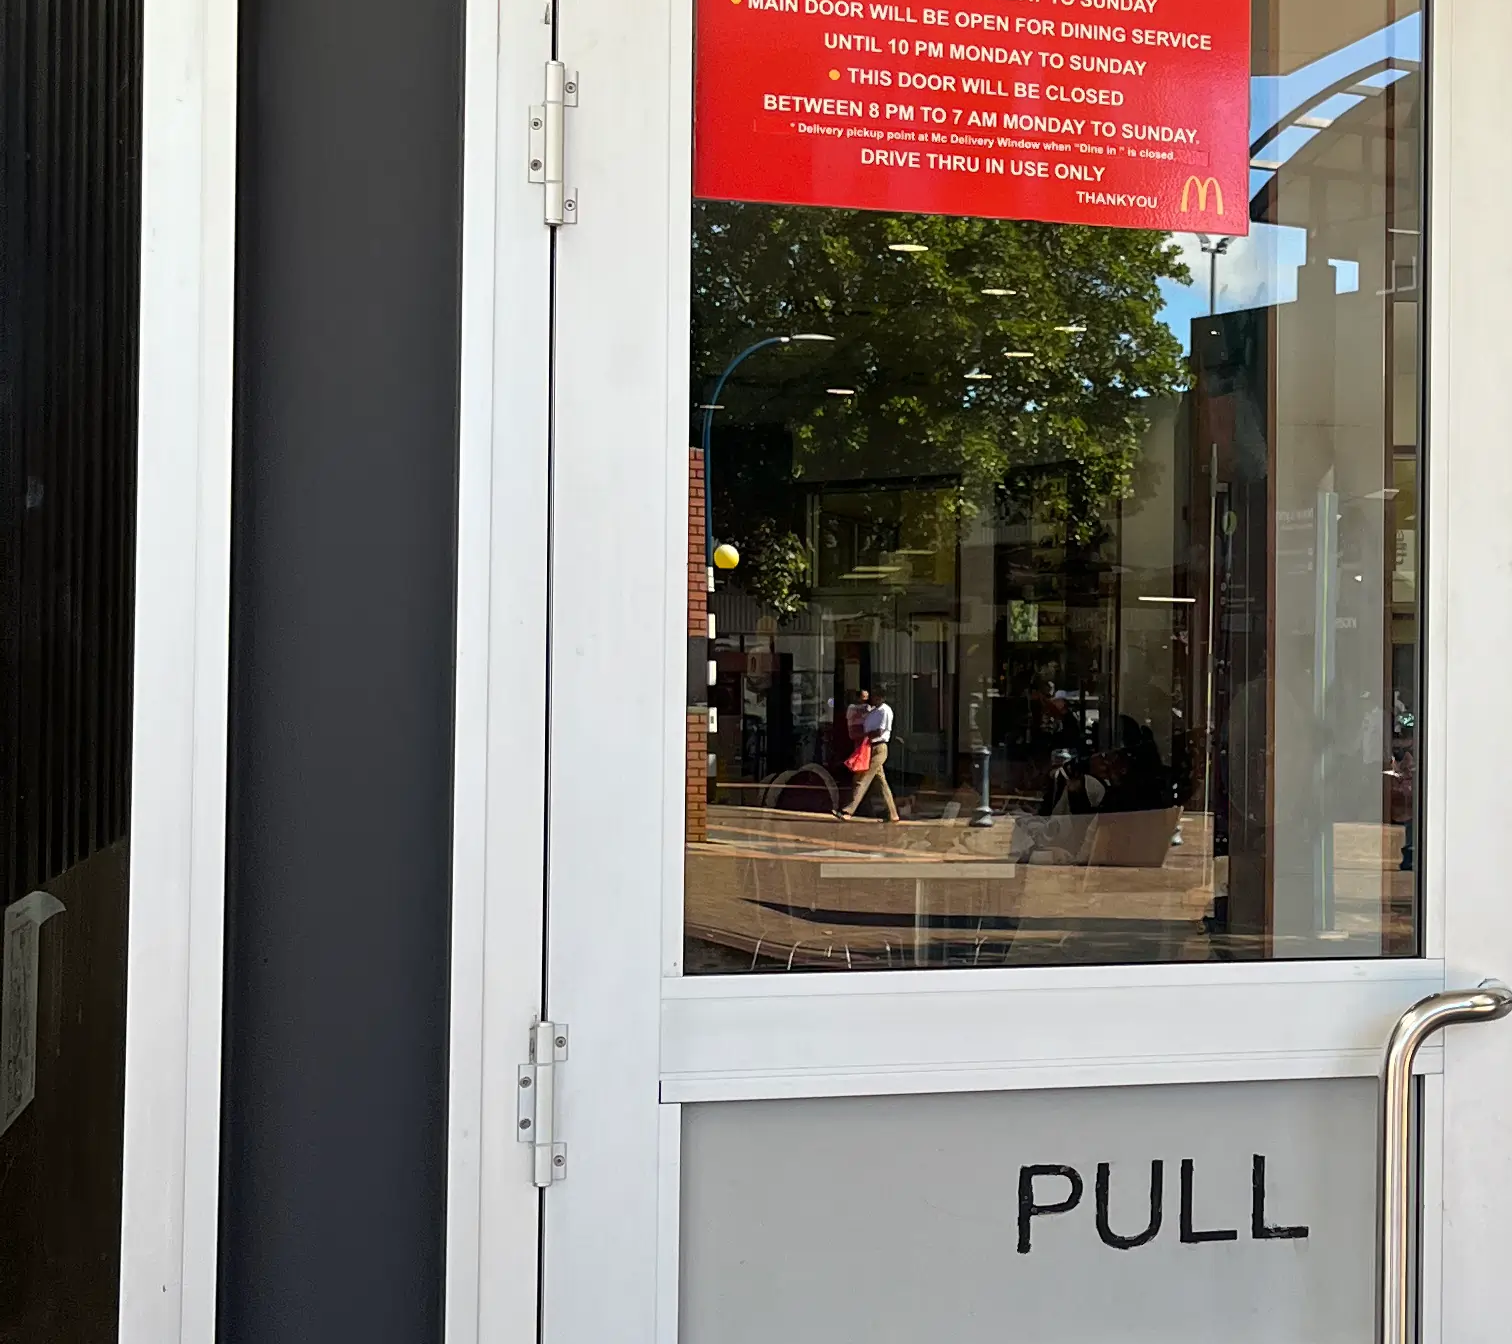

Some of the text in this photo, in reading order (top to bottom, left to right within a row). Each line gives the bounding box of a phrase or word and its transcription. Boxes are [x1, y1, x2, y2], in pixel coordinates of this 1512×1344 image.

[869, 3, 918, 23] WILL
[922, 8, 949, 26] BE
[955, 11, 1009, 32] OPEN
[1015, 17, 1055, 36] FOR
[1061, 21, 1126, 43] DINING
[1131, 28, 1211, 51] SERVICE
[824, 32, 1146, 76] UNTIL 10 PM MONDAY TO SUNDAY
[847, 67, 1124, 106] THIS DOOR WILL BE CLOSED
[764, 94, 1200, 145] BETWEEN 8 PM TO 7 AM MONDAY TO SUNDAY.
[798, 122, 844, 138] Delivery
[846, 127, 885, 141] pickup
[886, 130, 916, 141] point
[917, 132, 929, 142] at
[931, 132, 948, 144] Mc
[950, 133, 995, 149] Delivery
[996, 137, 1041, 150] Window
[1042, 141, 1072, 152] when
[1106, 145, 1117, 156] in
[1127, 146, 1137, 158] is
[861, 148, 1105, 182] DRIVE THRU IN USE ONLY
[1076, 191, 1159, 209] THANKYOU
[1017, 1154, 1308, 1254] PULL
